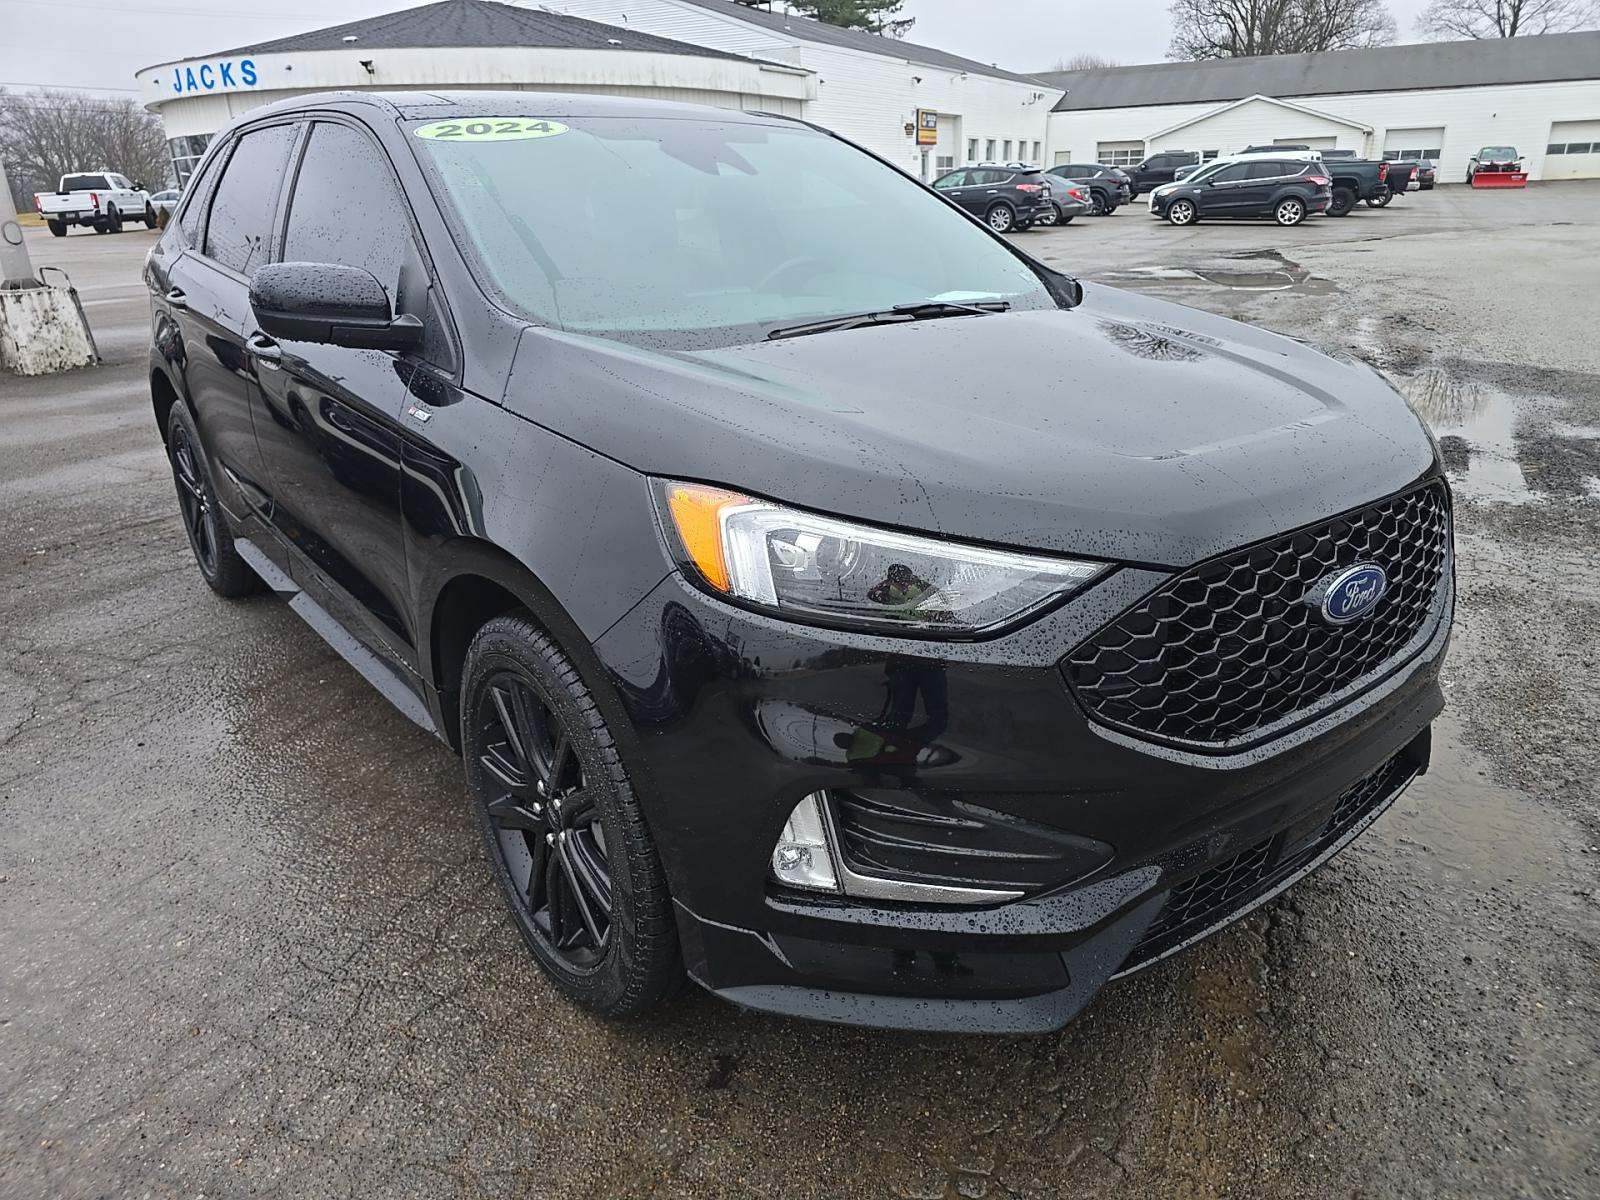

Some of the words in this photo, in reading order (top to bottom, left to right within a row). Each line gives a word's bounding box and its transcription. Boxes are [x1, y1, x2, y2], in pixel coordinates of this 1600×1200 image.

[173, 59, 257, 93] JACKS
[435, 121, 553, 138] 2024
[1342, 576, 1377, 613] Ford
